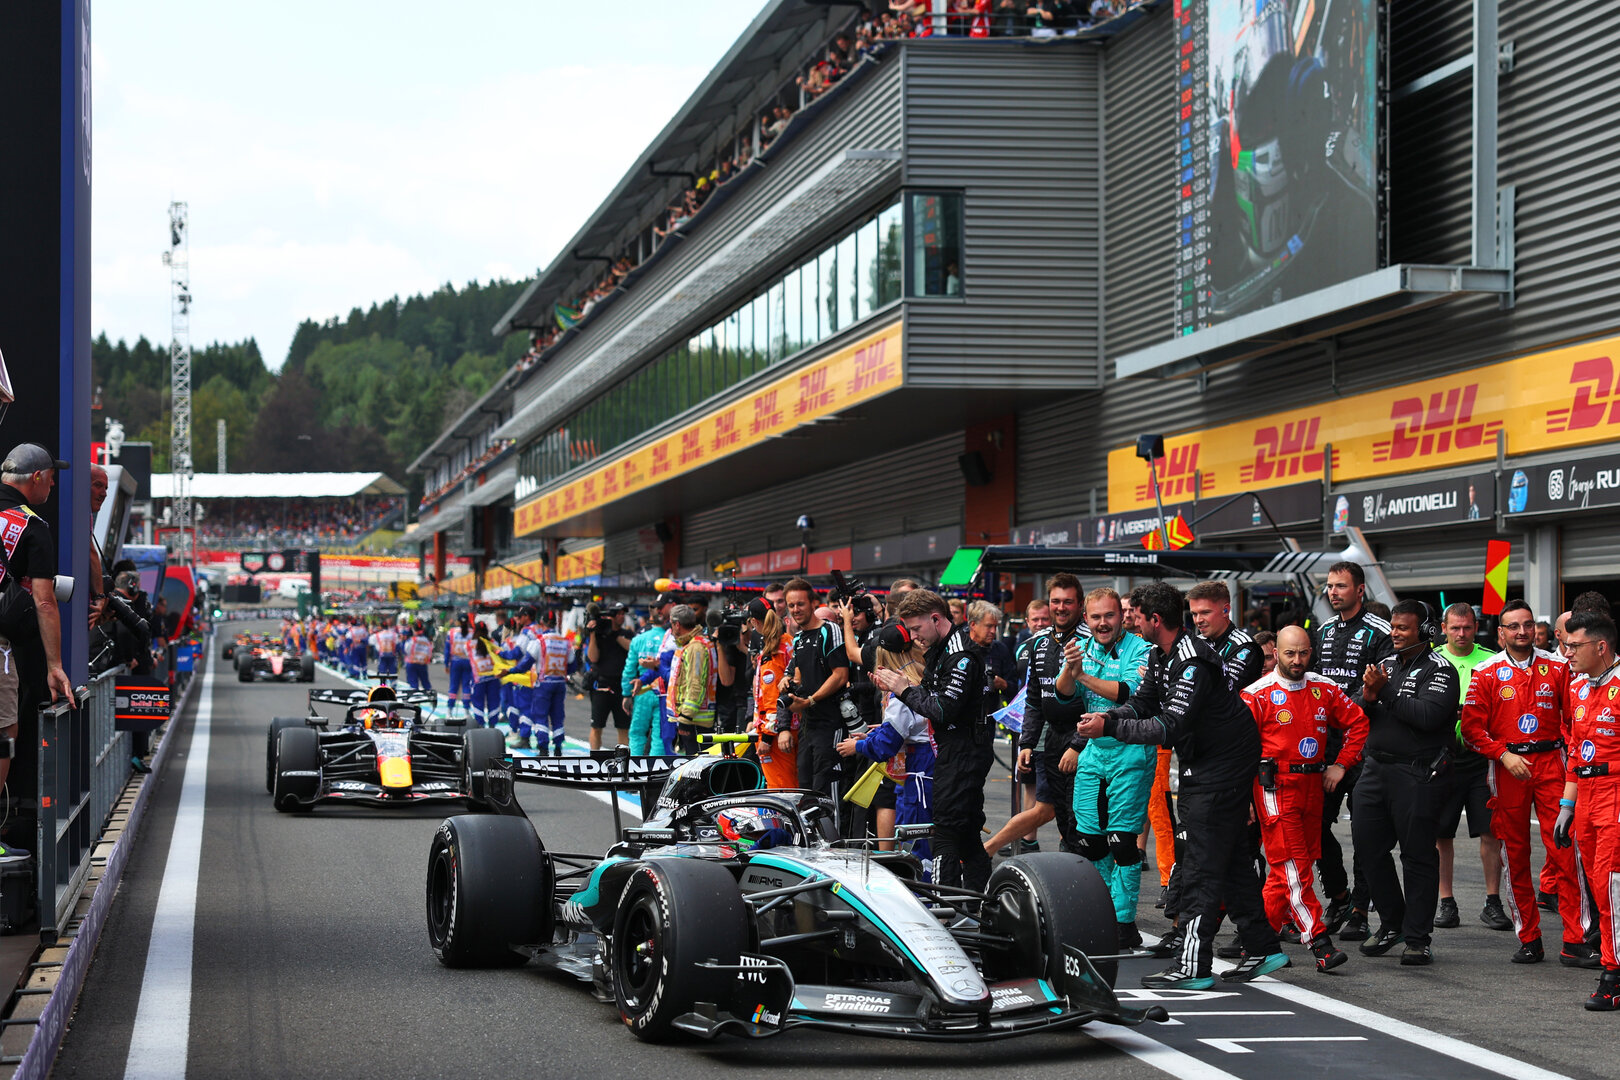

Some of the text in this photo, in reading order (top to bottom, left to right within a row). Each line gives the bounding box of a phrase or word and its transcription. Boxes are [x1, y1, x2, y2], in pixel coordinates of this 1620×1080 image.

[1389, 383, 1484, 461] DHL
[1252, 416, 1325, 482] DHL
[1548, 469, 1564, 500] 63
[1387, 491, 1457, 516] ANTONELLI
[1322, 667, 1358, 678] ETRONAS
[1500, 667, 1510, 681] hp
[1175, 690, 1189, 699] IWC
[1273, 690, 1284, 704] hp
[1521, 714, 1536, 733] hp
[1302, 737, 1317, 757] hp
[338, 782, 366, 790] VISA
[705, 798, 746, 808] CROWDSTRIKE
[758, 875, 783, 887] AMG
[737, 955, 768, 984] IWC
[1065, 955, 1080, 977] EOS
[825, 993, 892, 1005] PETRONAS
[991, 987, 1023, 1000] RONAS
[822, 1001, 890, 1013] Syntium
[991, 993, 1035, 1010] yntium
[760, 1008, 781, 1026] Microsoft
